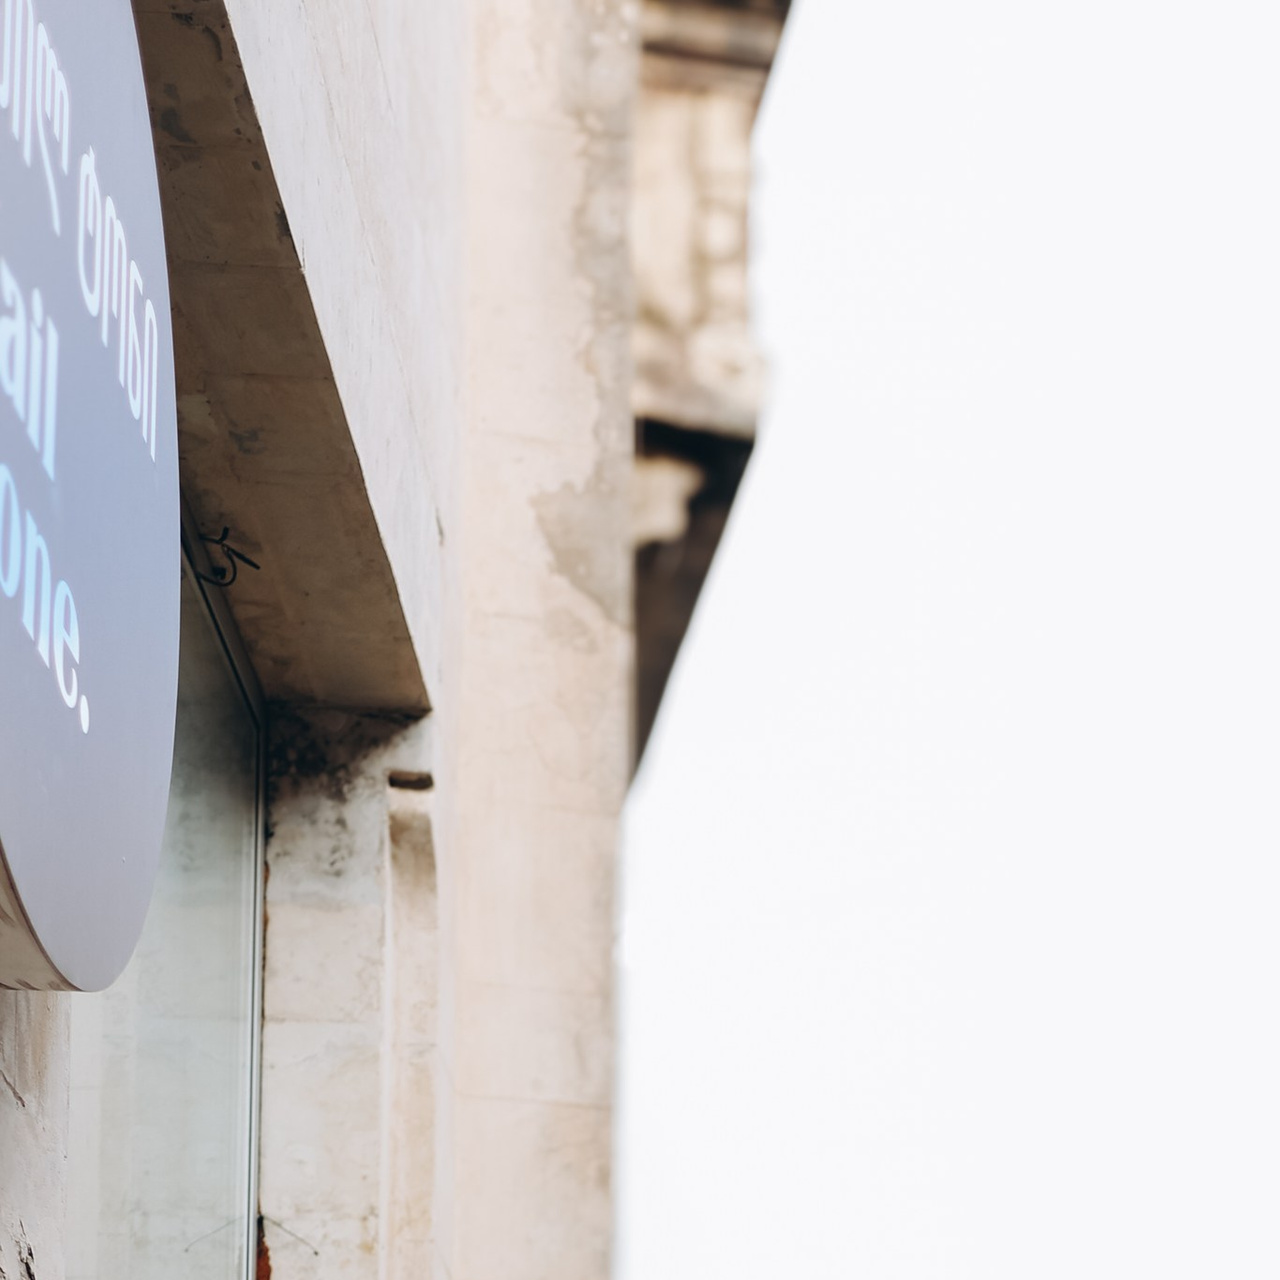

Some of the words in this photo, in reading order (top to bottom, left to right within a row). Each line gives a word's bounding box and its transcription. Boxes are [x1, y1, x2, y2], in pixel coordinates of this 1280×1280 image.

[0, 256, 58, 484] ail
[78, 145, 157, 463] ტონი
[0, 463, 90, 734] one.
